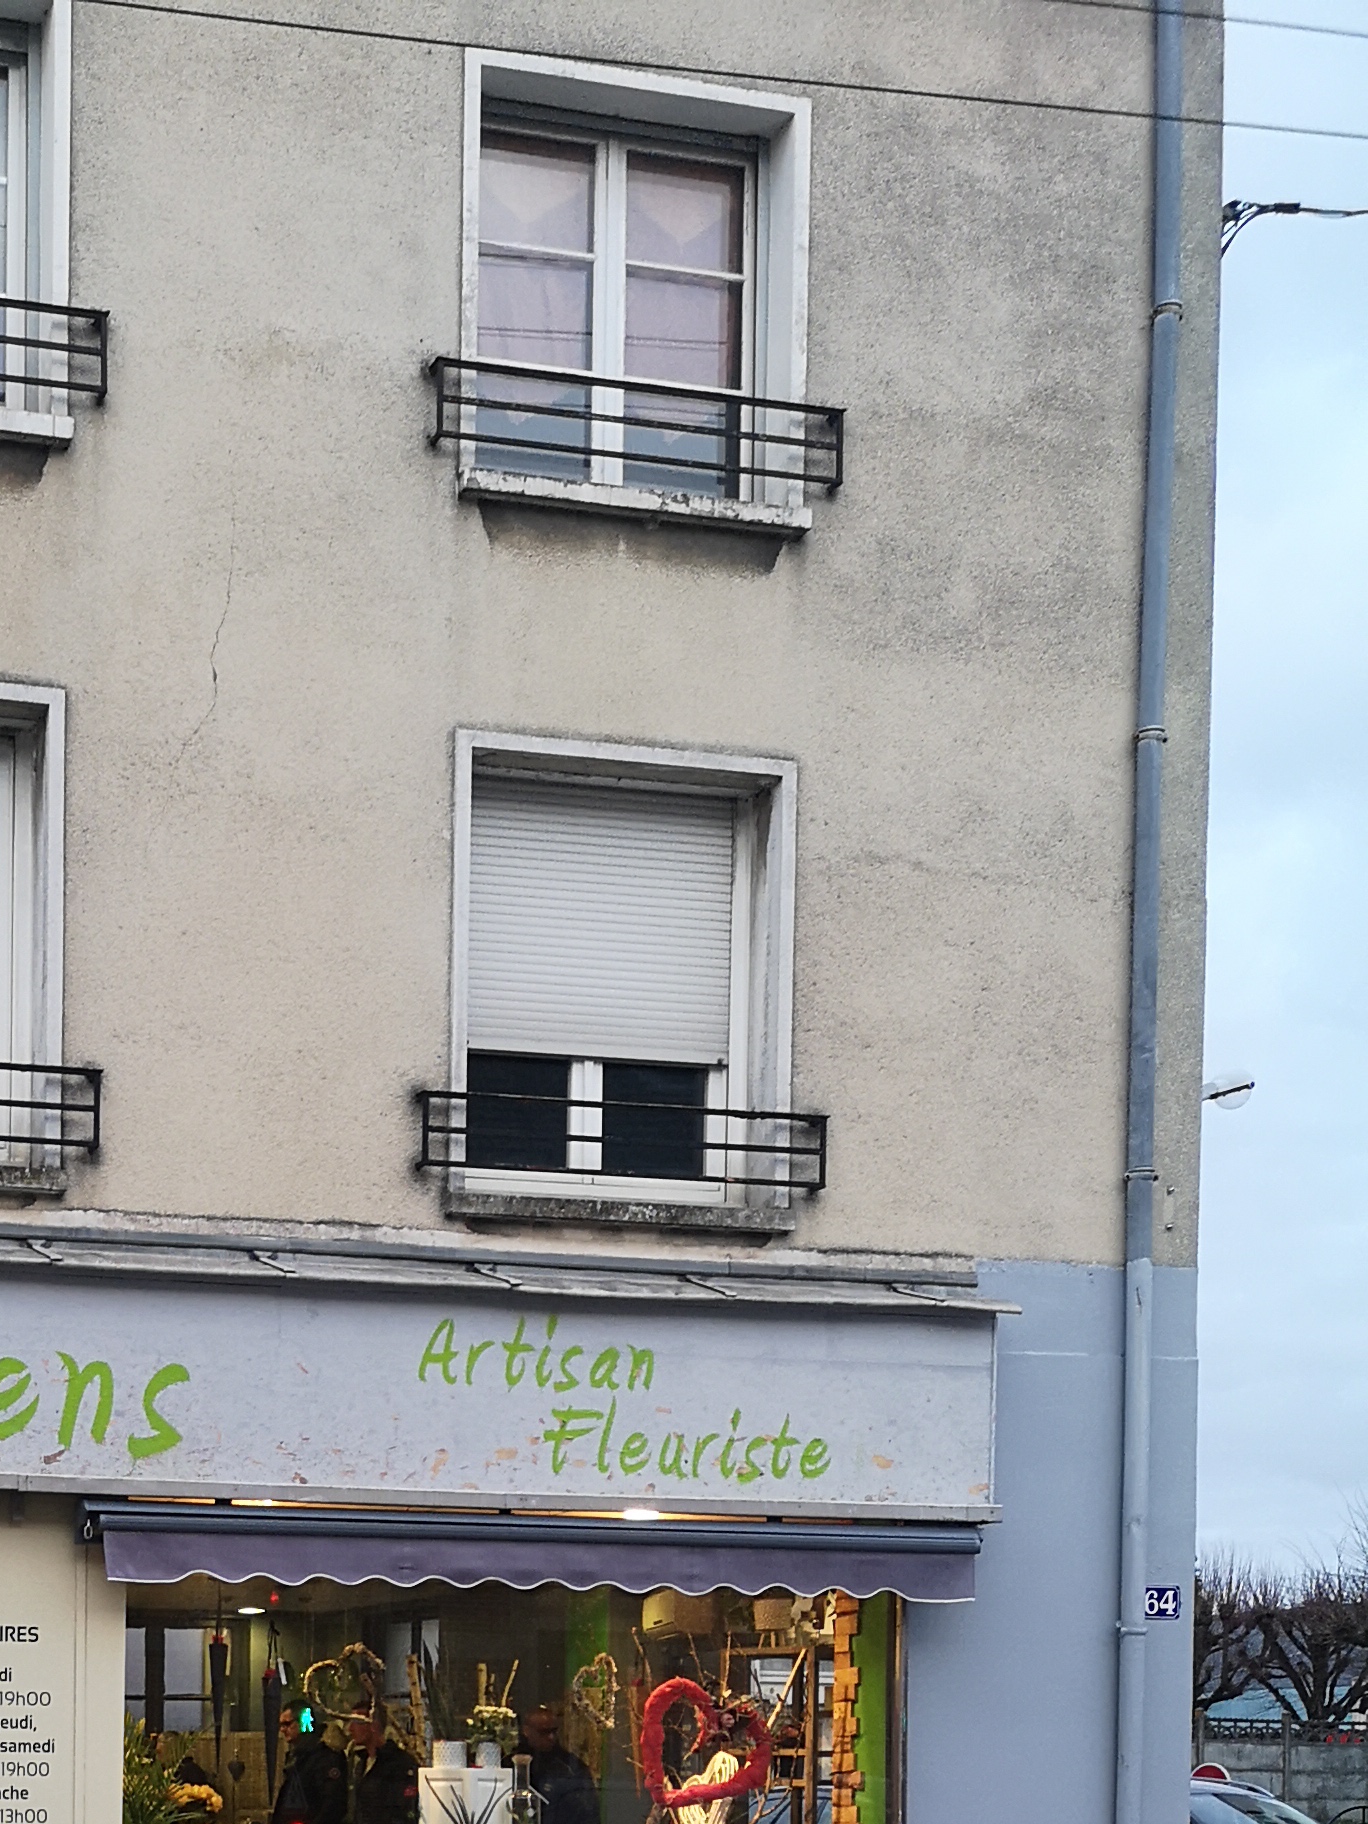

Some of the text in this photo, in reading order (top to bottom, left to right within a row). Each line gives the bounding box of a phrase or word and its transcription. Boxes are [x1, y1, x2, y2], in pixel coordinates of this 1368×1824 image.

[418, 1314, 654, 1392] Artisan
[543, 1397, 831, 1484] Fleuriste
[1145, 1590, 1176, 1615] 64
[0, 1690, 52, 1707] 19h00
[0, 1738, 55, 1754] samedi
[1, 1761, 50, 1777] 19h00
[0, 1808, 48, 1824] 13h00
